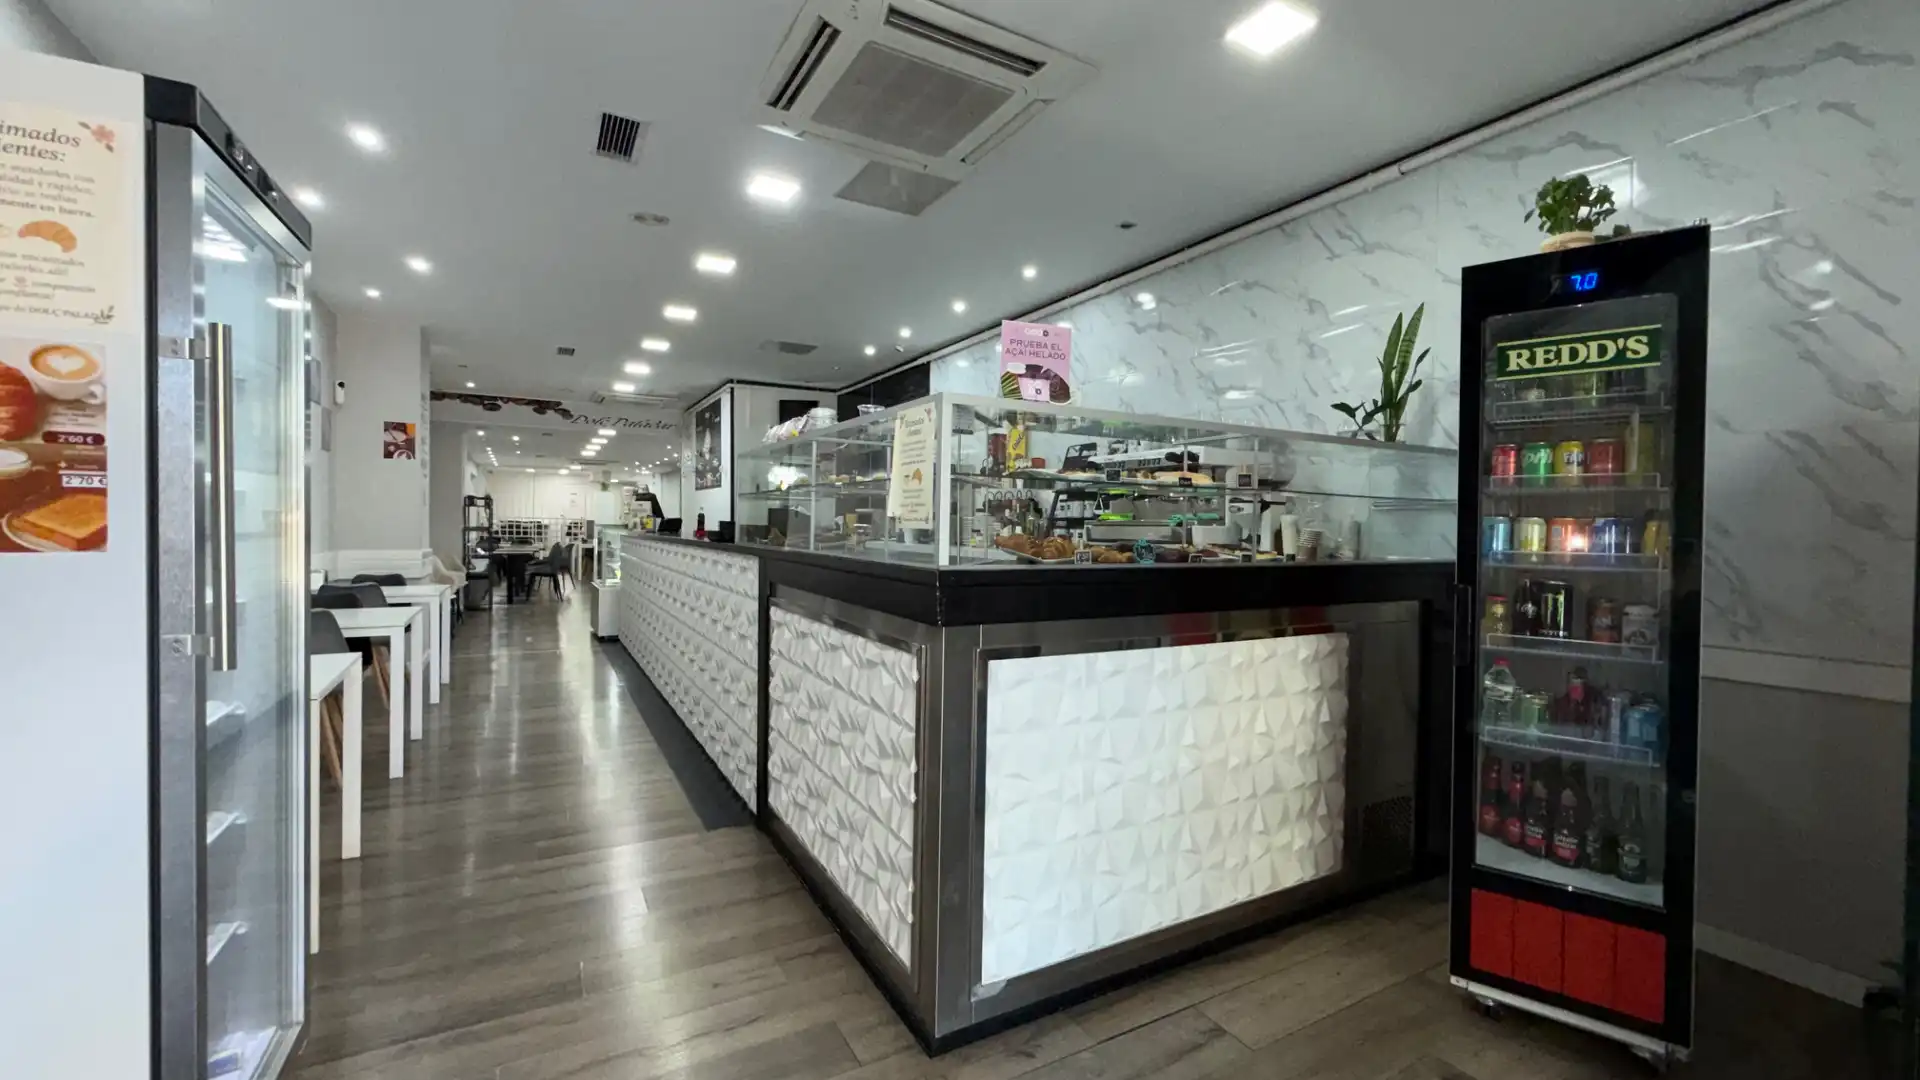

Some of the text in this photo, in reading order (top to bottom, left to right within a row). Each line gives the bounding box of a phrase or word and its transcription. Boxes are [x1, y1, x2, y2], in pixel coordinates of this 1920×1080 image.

[1009, 338, 1063, 352] PRUEBA EL
[1028, 349, 1067, 361] HELADO
[1506, 335, 1650, 371] REDD'S
